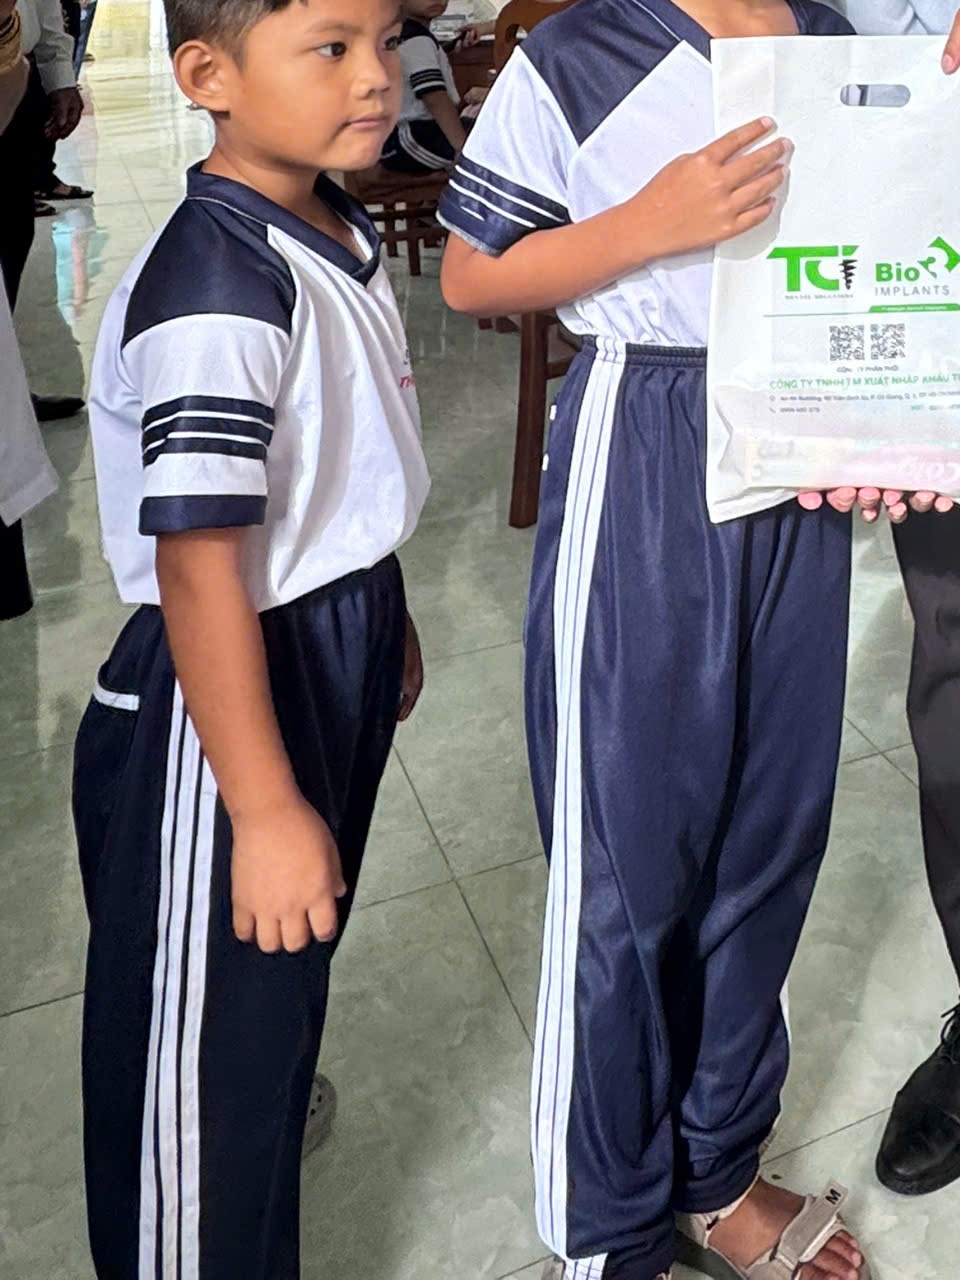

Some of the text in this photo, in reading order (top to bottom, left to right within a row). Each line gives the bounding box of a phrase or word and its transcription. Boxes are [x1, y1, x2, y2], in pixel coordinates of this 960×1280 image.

[875, 285, 950, 297] IMPLANTS
[769, 378, 798, 389] CÔNG
[800, 379, 813, 389] TY
[815, 379, 844, 388] TNHH
